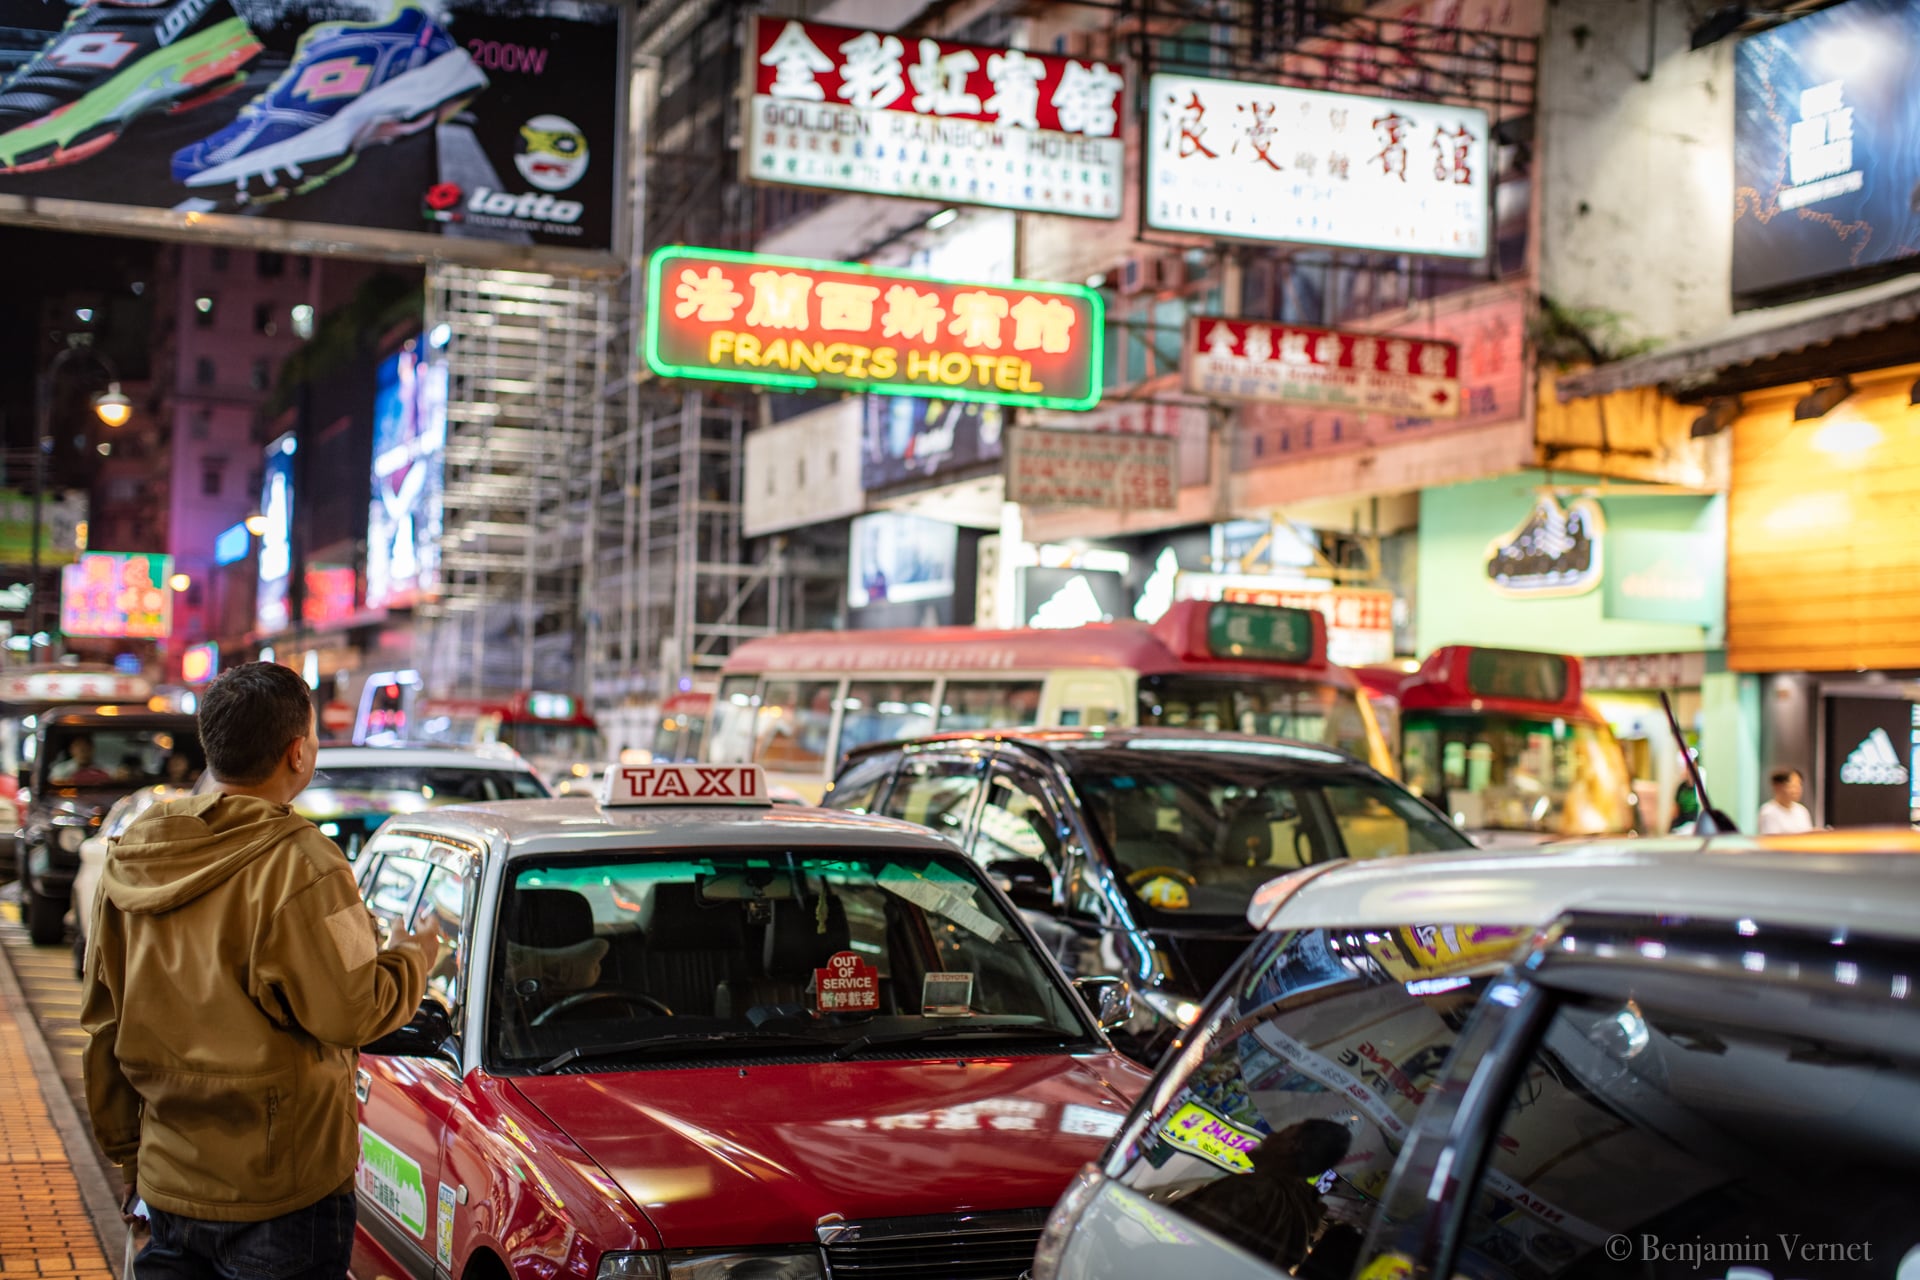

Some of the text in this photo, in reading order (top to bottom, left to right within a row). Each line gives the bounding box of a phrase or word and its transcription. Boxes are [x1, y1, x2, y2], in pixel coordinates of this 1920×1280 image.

[467, 38, 549, 75] 200W
[763, 104, 869, 135] GOLDEN
[1028, 137, 1112, 166] HOTEL
[467, 186, 584, 224] Lotto
[675, 267, 1076, 355] 法蘭西斯賓館
[708, 329, 1044, 394] FRANCIS HOTEL
[622, 768, 756, 797] TAXI
[833, 955, 858, 968] OUT
[838, 968, 855, 978] OF
[821, 991, 875, 1008] 暫停載客
[823, 977, 872, 989] SERVICE
